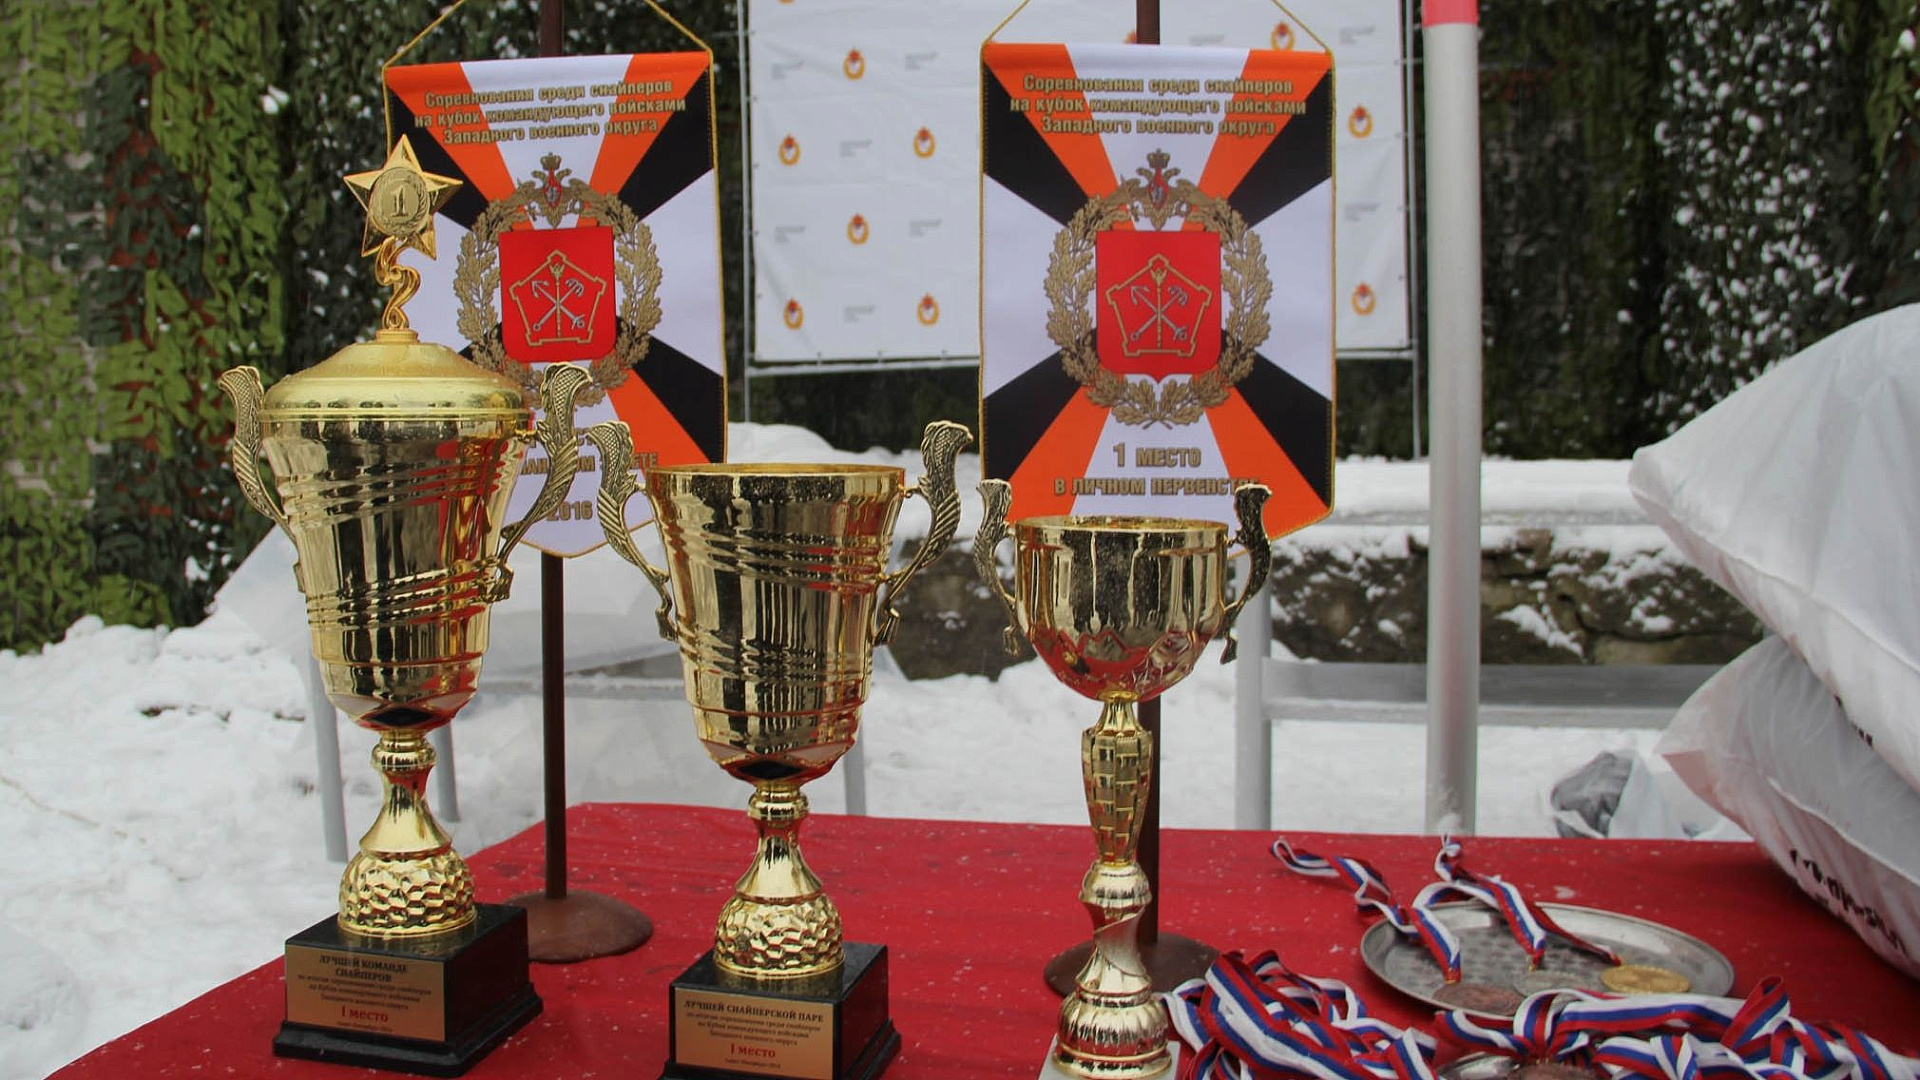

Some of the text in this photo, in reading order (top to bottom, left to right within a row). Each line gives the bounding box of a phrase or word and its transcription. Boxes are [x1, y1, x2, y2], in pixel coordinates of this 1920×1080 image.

[425, 79, 672, 109] Соревнования среди снайперов
[1023, 74, 1293, 95] Соревнования среди снайперов
[414, 113, 432, 128] на
[485, 103, 605, 123] командующего
[609, 96, 686, 114] войсками
[1010, 97, 1030, 111] на
[1089, 98, 1220, 116] командующего
[1224, 98, 1306, 115] войсками
[443, 118, 659, 144] Западного военного округа
[1041, 116, 1276, 137] Западного военного округа
[1113, 442, 1202, 468] 1 МЕСТО
[1053, 478, 1065, 495] В
[1072, 478, 1146, 496] ЛИЧНОМ
